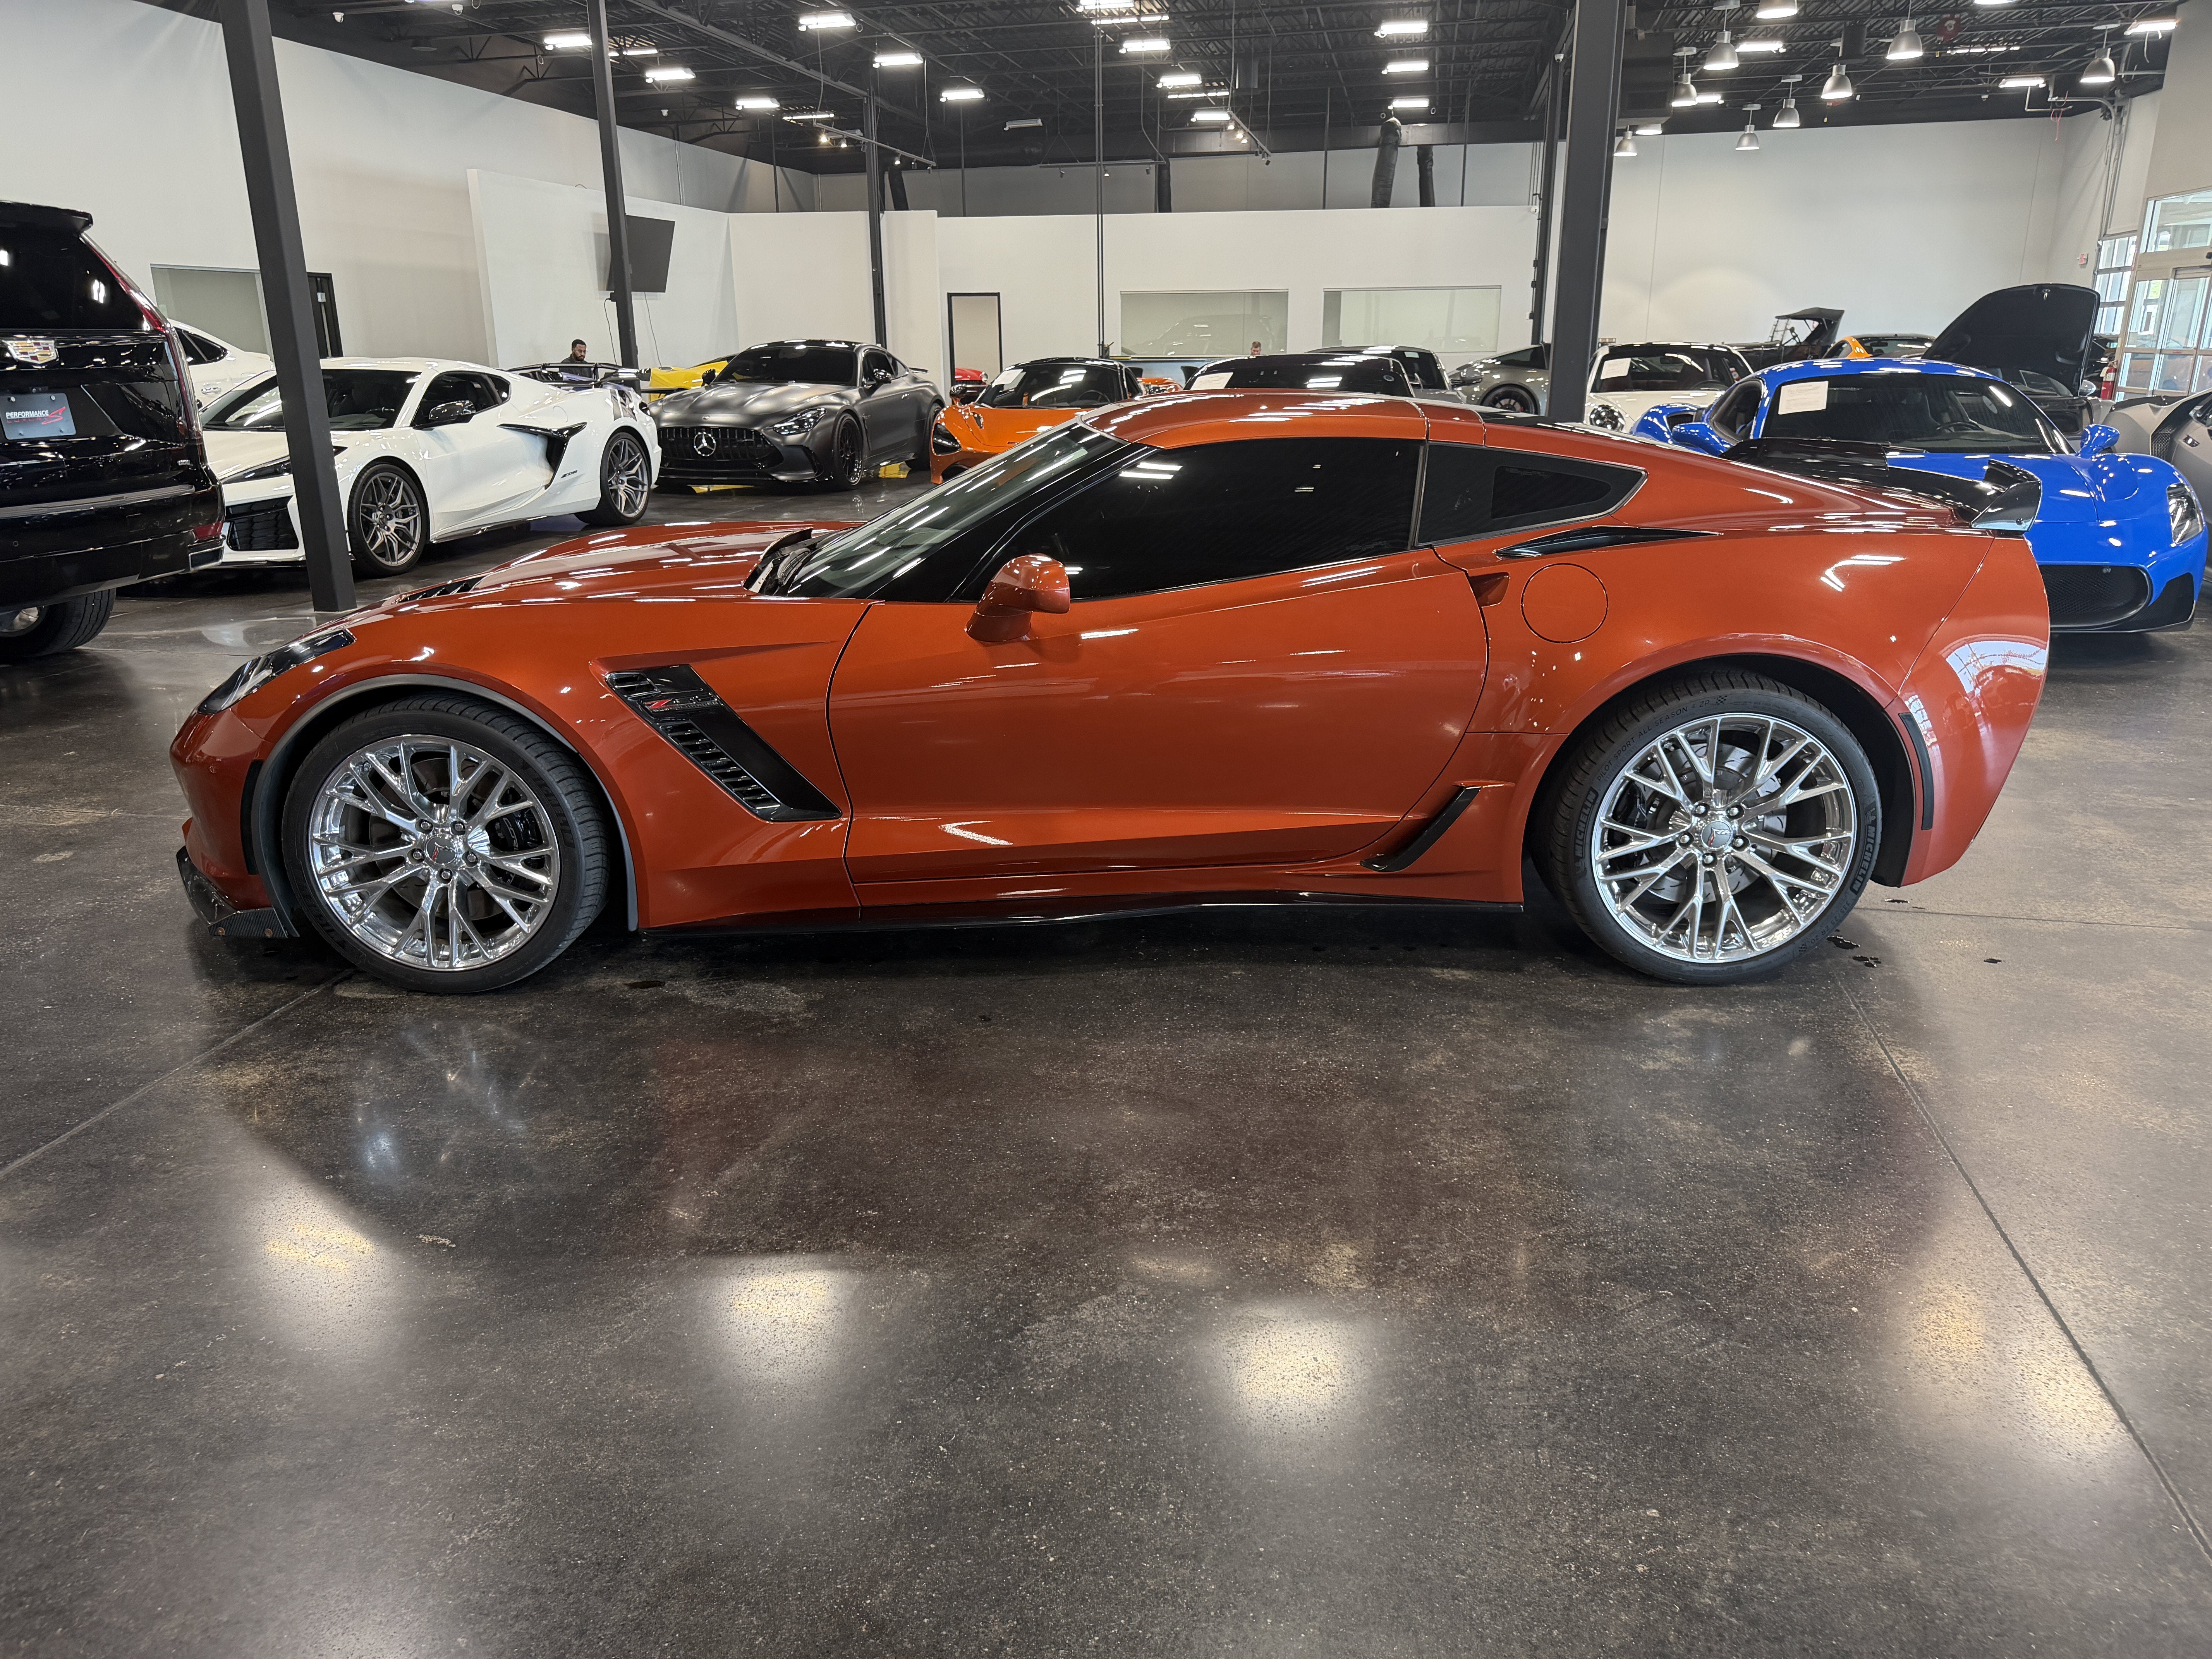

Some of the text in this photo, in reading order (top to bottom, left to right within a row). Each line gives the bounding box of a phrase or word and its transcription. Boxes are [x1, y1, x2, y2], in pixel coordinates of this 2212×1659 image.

[6, 410, 49, 419] PERFORMANCE
[560, 470, 577, 479] Z06
[1597, 760, 1612, 782] PILOT
[1614, 737, 1635, 760] SPORT
[1638, 726, 1652, 739] ALL
[1654, 706, 1688, 726] SEASON
[1700, 699, 1710, 708] ZP
[526, 767, 574, 845] MICHELIN
[1575, 790, 1596, 858] MICHELIN
[1852, 826, 1875, 891] MICHELIN
